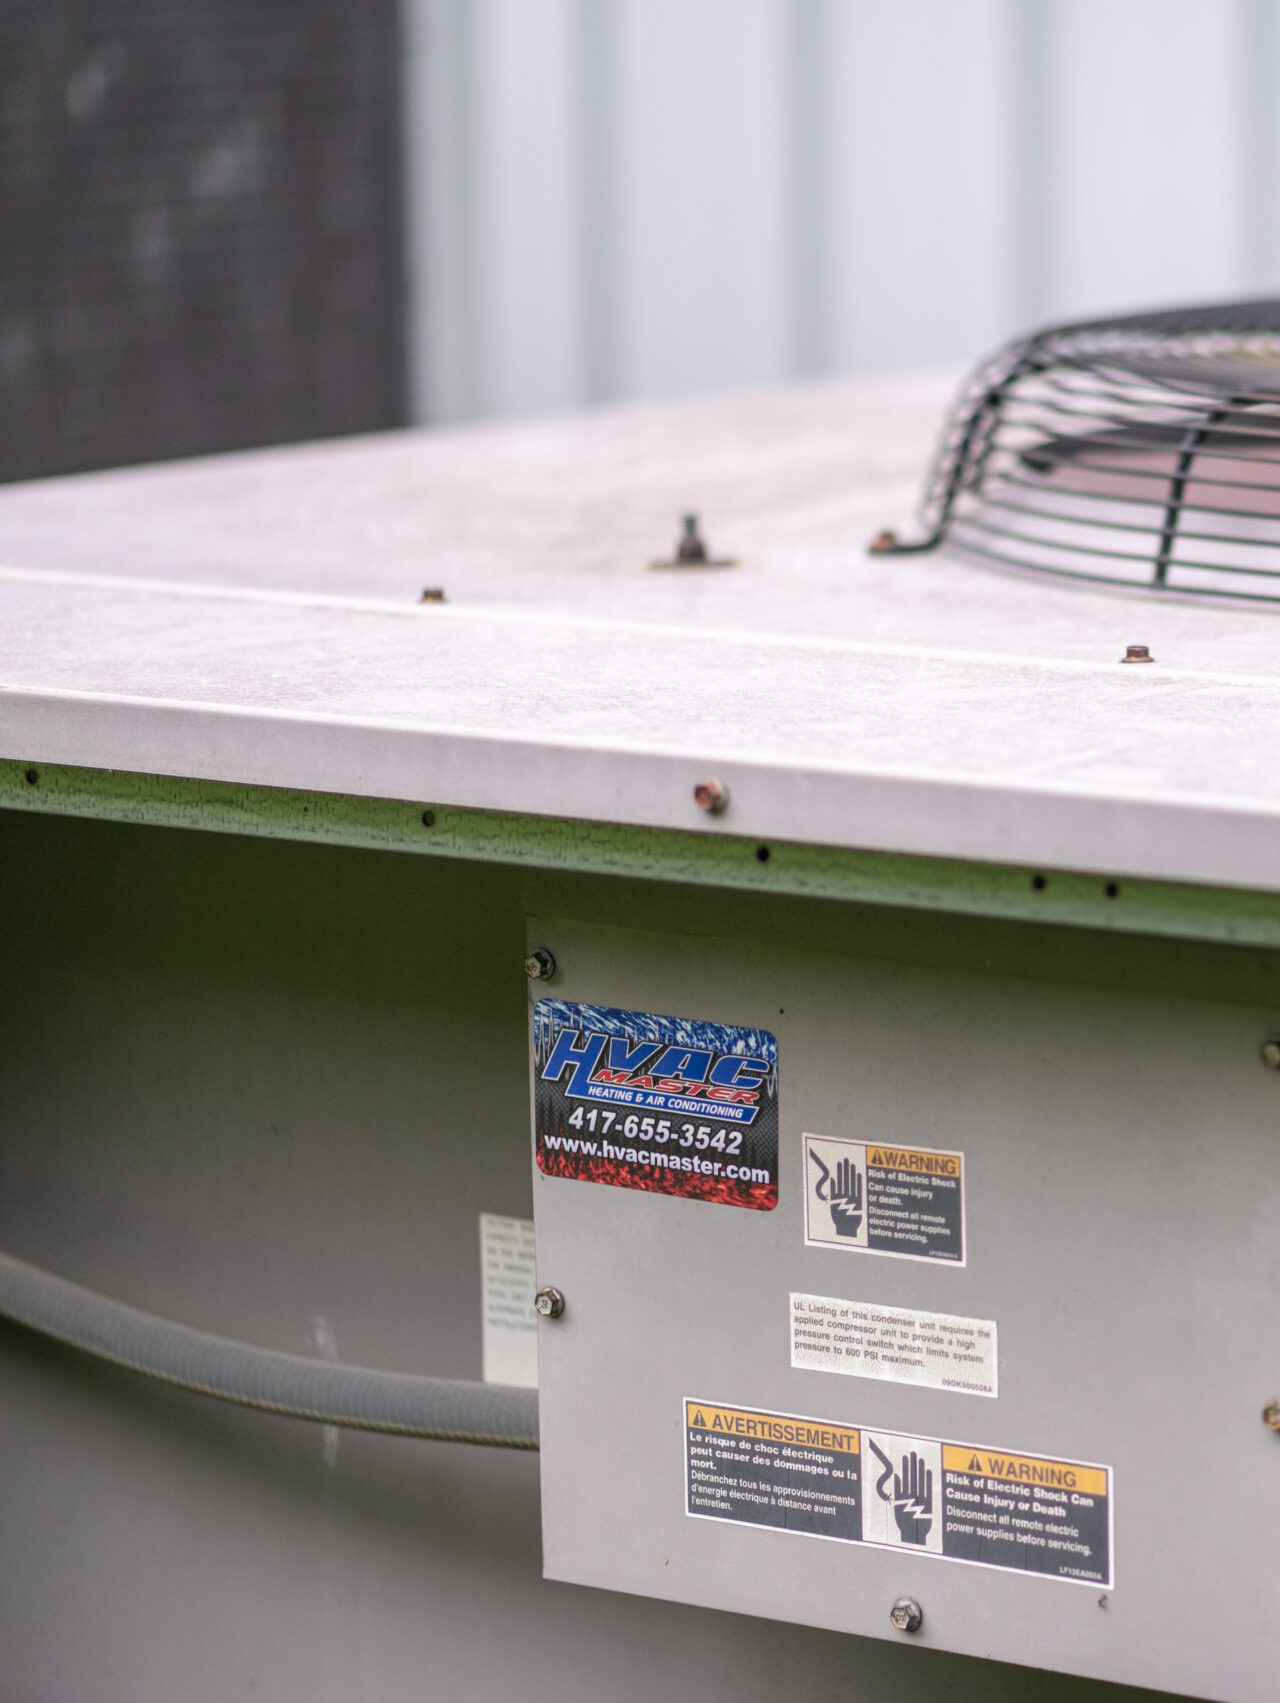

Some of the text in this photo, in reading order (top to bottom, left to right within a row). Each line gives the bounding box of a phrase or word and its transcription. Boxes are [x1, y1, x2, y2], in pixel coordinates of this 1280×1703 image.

[541, 1028, 770, 1093] HVAC
[588, 1086, 743, 1118] HEATING & AIR CONDITIONING
[592, 1070, 760, 1104] MASTER
[568, 1107, 743, 1154] 417-655-3542
[544, 1134, 770, 1184] www.hvacmaster.com
[884, 1151, 956, 1174] WARNING
[868, 1169, 885, 1179] Risk
[898, 1173, 929, 1184] Electric
[931, 1177, 956, 1188] Shock
[869, 1182, 933, 1200] Can cause injury
[869, 1207, 946, 1224] Disconnect all remote
[879, 1195, 903, 1205] death.
[869, 1218, 951, 1235] electric power supplies
[870, 1228, 892, 1237] before
[794, 1302, 991, 1338] UL Listing of this condenser unit requires the
[794, 1315, 824, 1326] applied
[827, 1320, 877, 1334] compressor
[881, 1327, 896, 1337] unit
[900, 1331, 909, 1339] to
[913, 1332, 944, 1345] provide
[956, 1338, 975, 1350] high
[794, 1328, 983, 1363] pressure control switch which limits system
[794, 1342, 925, 1367] pressure to 600 PSI maximum.
[690, 1432, 834, 1464] Le risque de choc électrique
[712, 1414, 855, 1451] AVERTISSEMENT
[691, 1447, 857, 1480] peut causer des dommages ou la
[691, 1460, 717, 1470] mort.
[988, 1458, 1076, 1487] WARNING
[692, 1470, 855, 1505] Débranchez tous les approvisionnements
[730, 1489, 769, 1504] électrique
[771, 1495, 776, 1505] à
[778, 1498, 812, 1511] distance
[814, 1505, 836, 1515] avant
[946, 1474, 1094, 1507] Risk of Electric Shock Can
[946, 1489, 1066, 1517] Cause Injury or Death
[947, 1505, 1079, 1537] Disconnect all remote electric
[947, 1522, 974, 1534] power
[977, 1526, 1014, 1541] supplies
[1017, 1533, 1045, 1547] before
